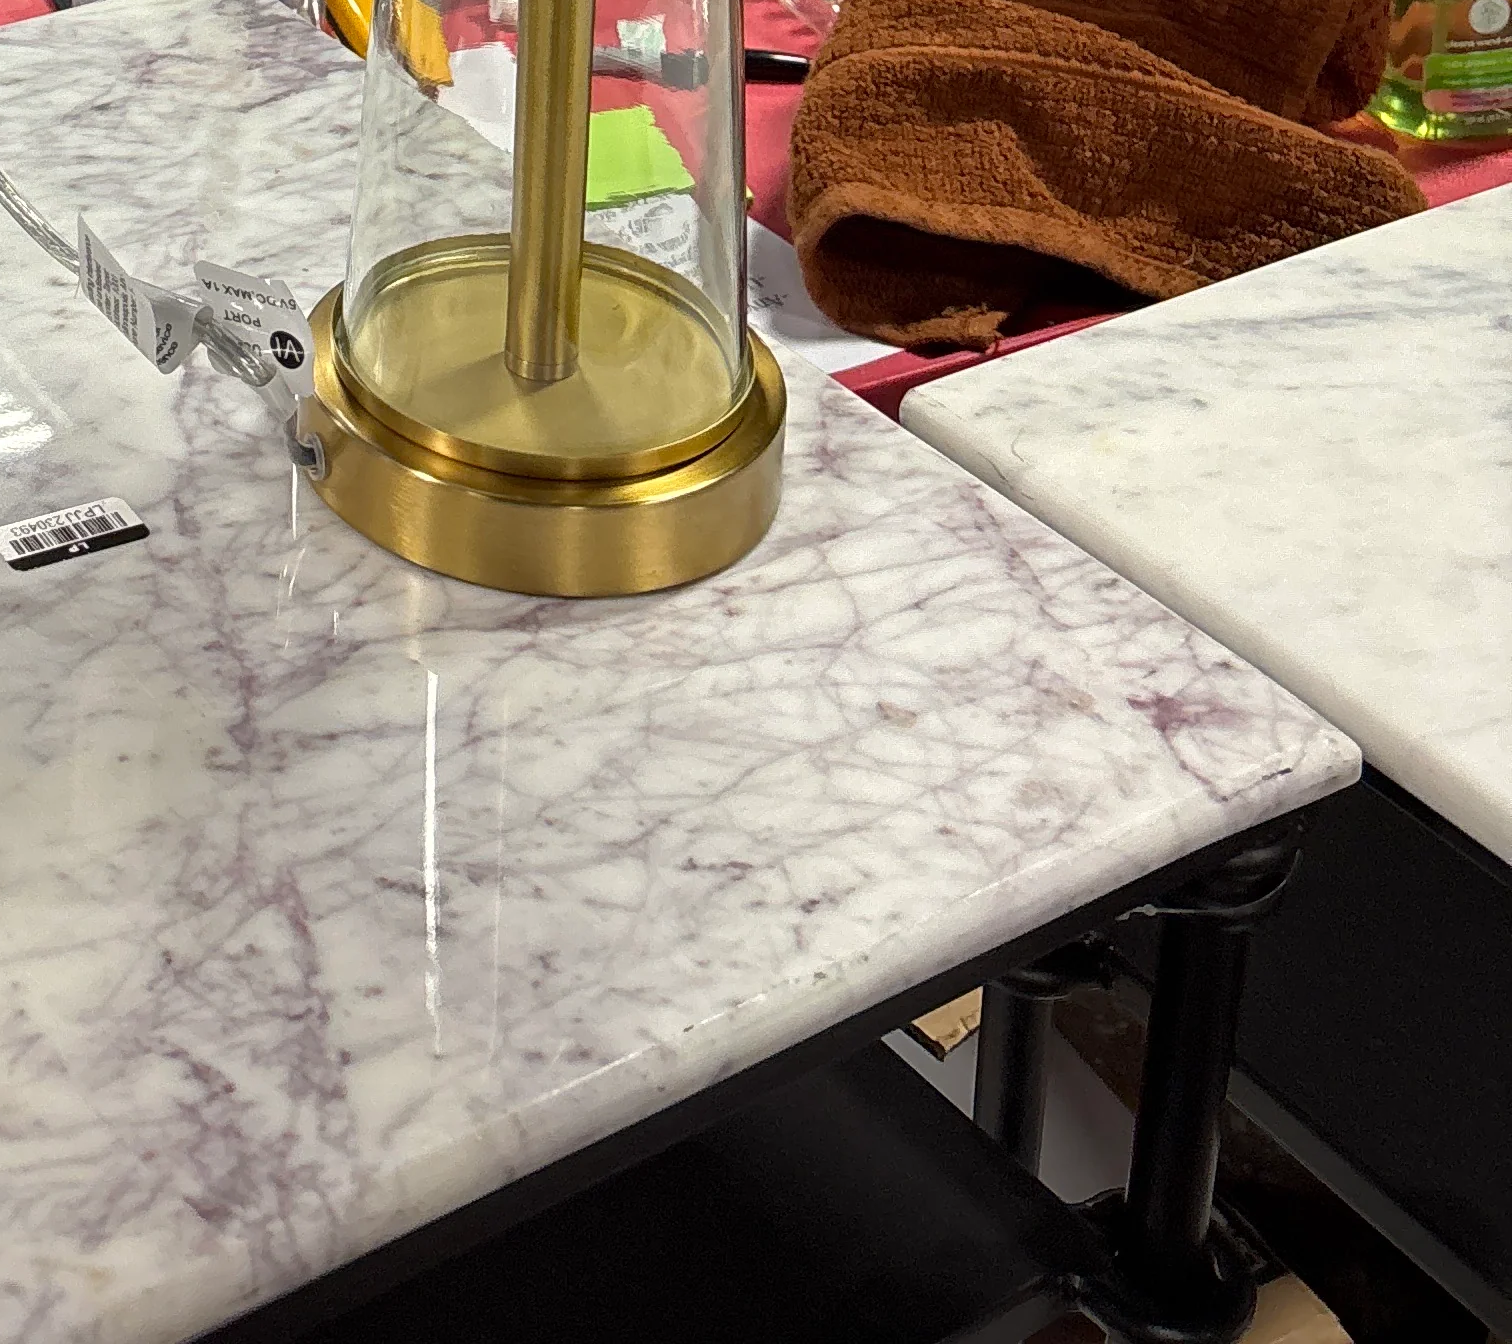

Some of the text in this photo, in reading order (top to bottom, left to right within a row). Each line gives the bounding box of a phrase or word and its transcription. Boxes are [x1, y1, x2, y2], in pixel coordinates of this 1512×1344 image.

[223, 309, 262, 328] PORT
[9, 504, 106, 537] LPJJ230493
[68, 542, 90, 554] LP
